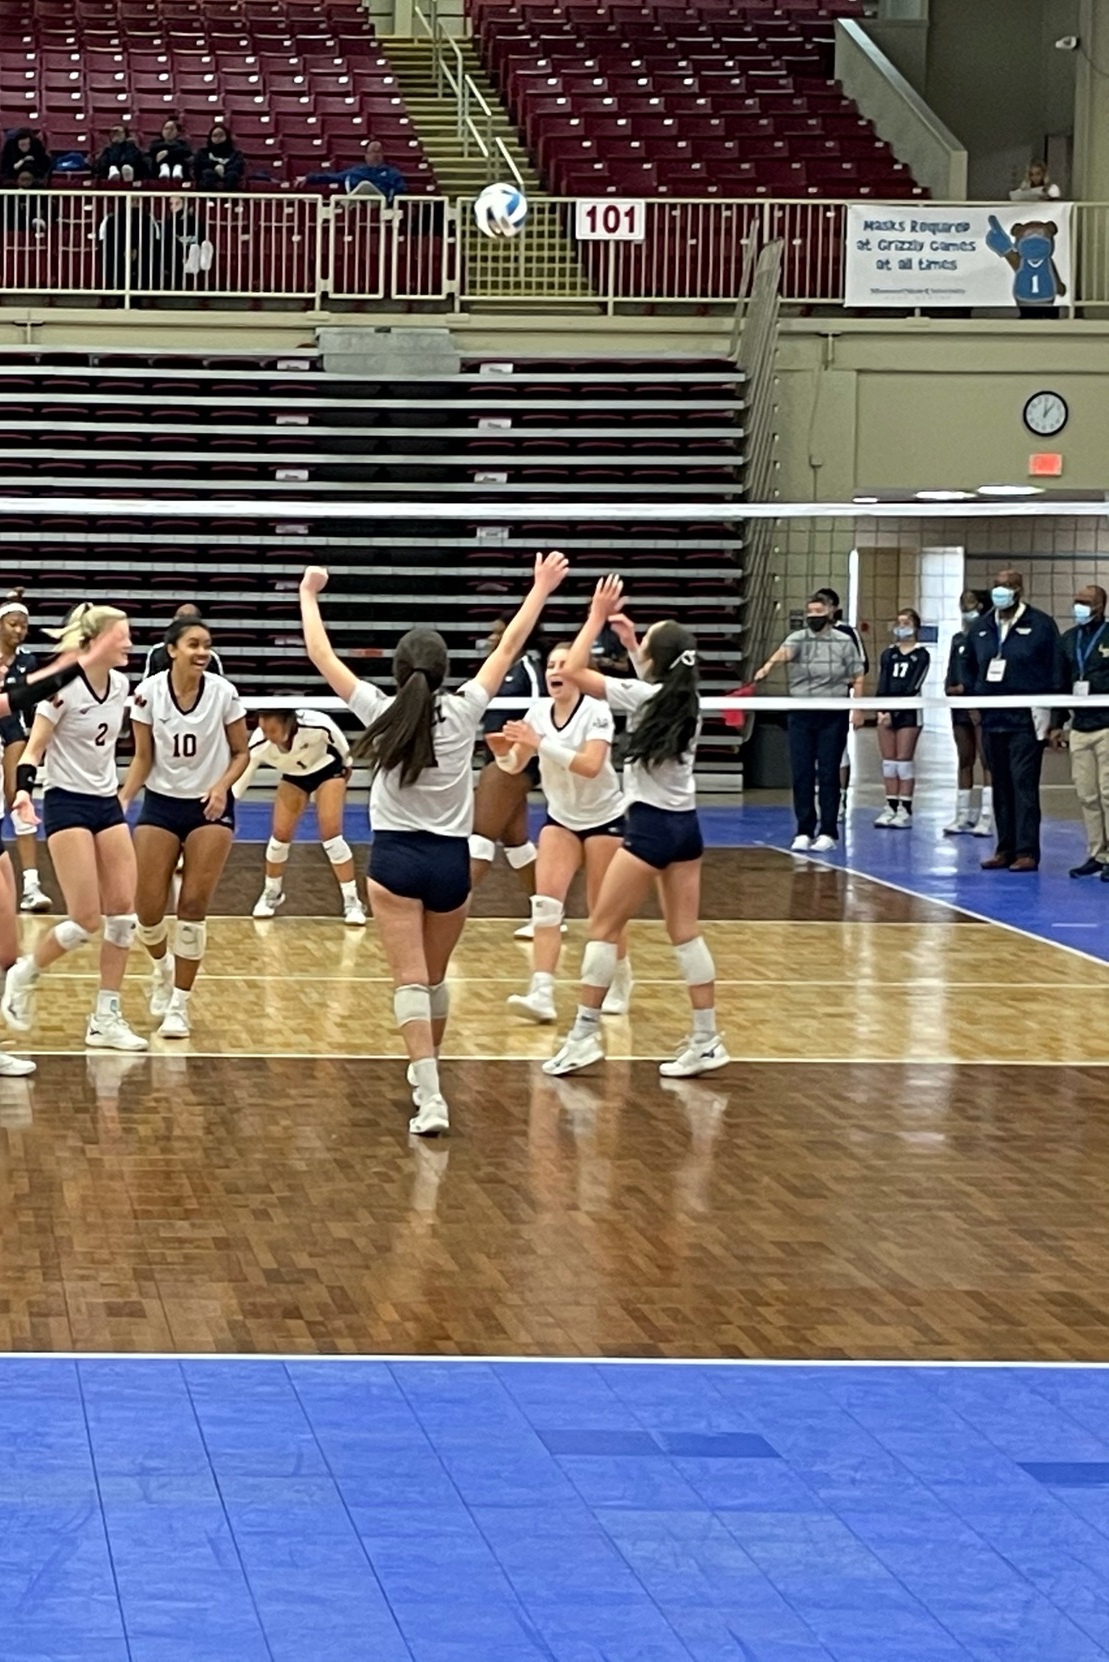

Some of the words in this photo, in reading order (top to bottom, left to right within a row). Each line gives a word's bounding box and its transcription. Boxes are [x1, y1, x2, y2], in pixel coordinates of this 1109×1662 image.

[586, 204, 635, 234] 101
[863, 220, 906, 232] Masks
[856, 239, 872, 251] at
[877, 238, 924, 252] Grizzly
[876, 258, 892, 271] at
[1031, 275, 1039, 293] 1
[892, 662, 909, 678] 17
[95, 723, 109, 747] 2
[172, 733, 197, 758] 10
